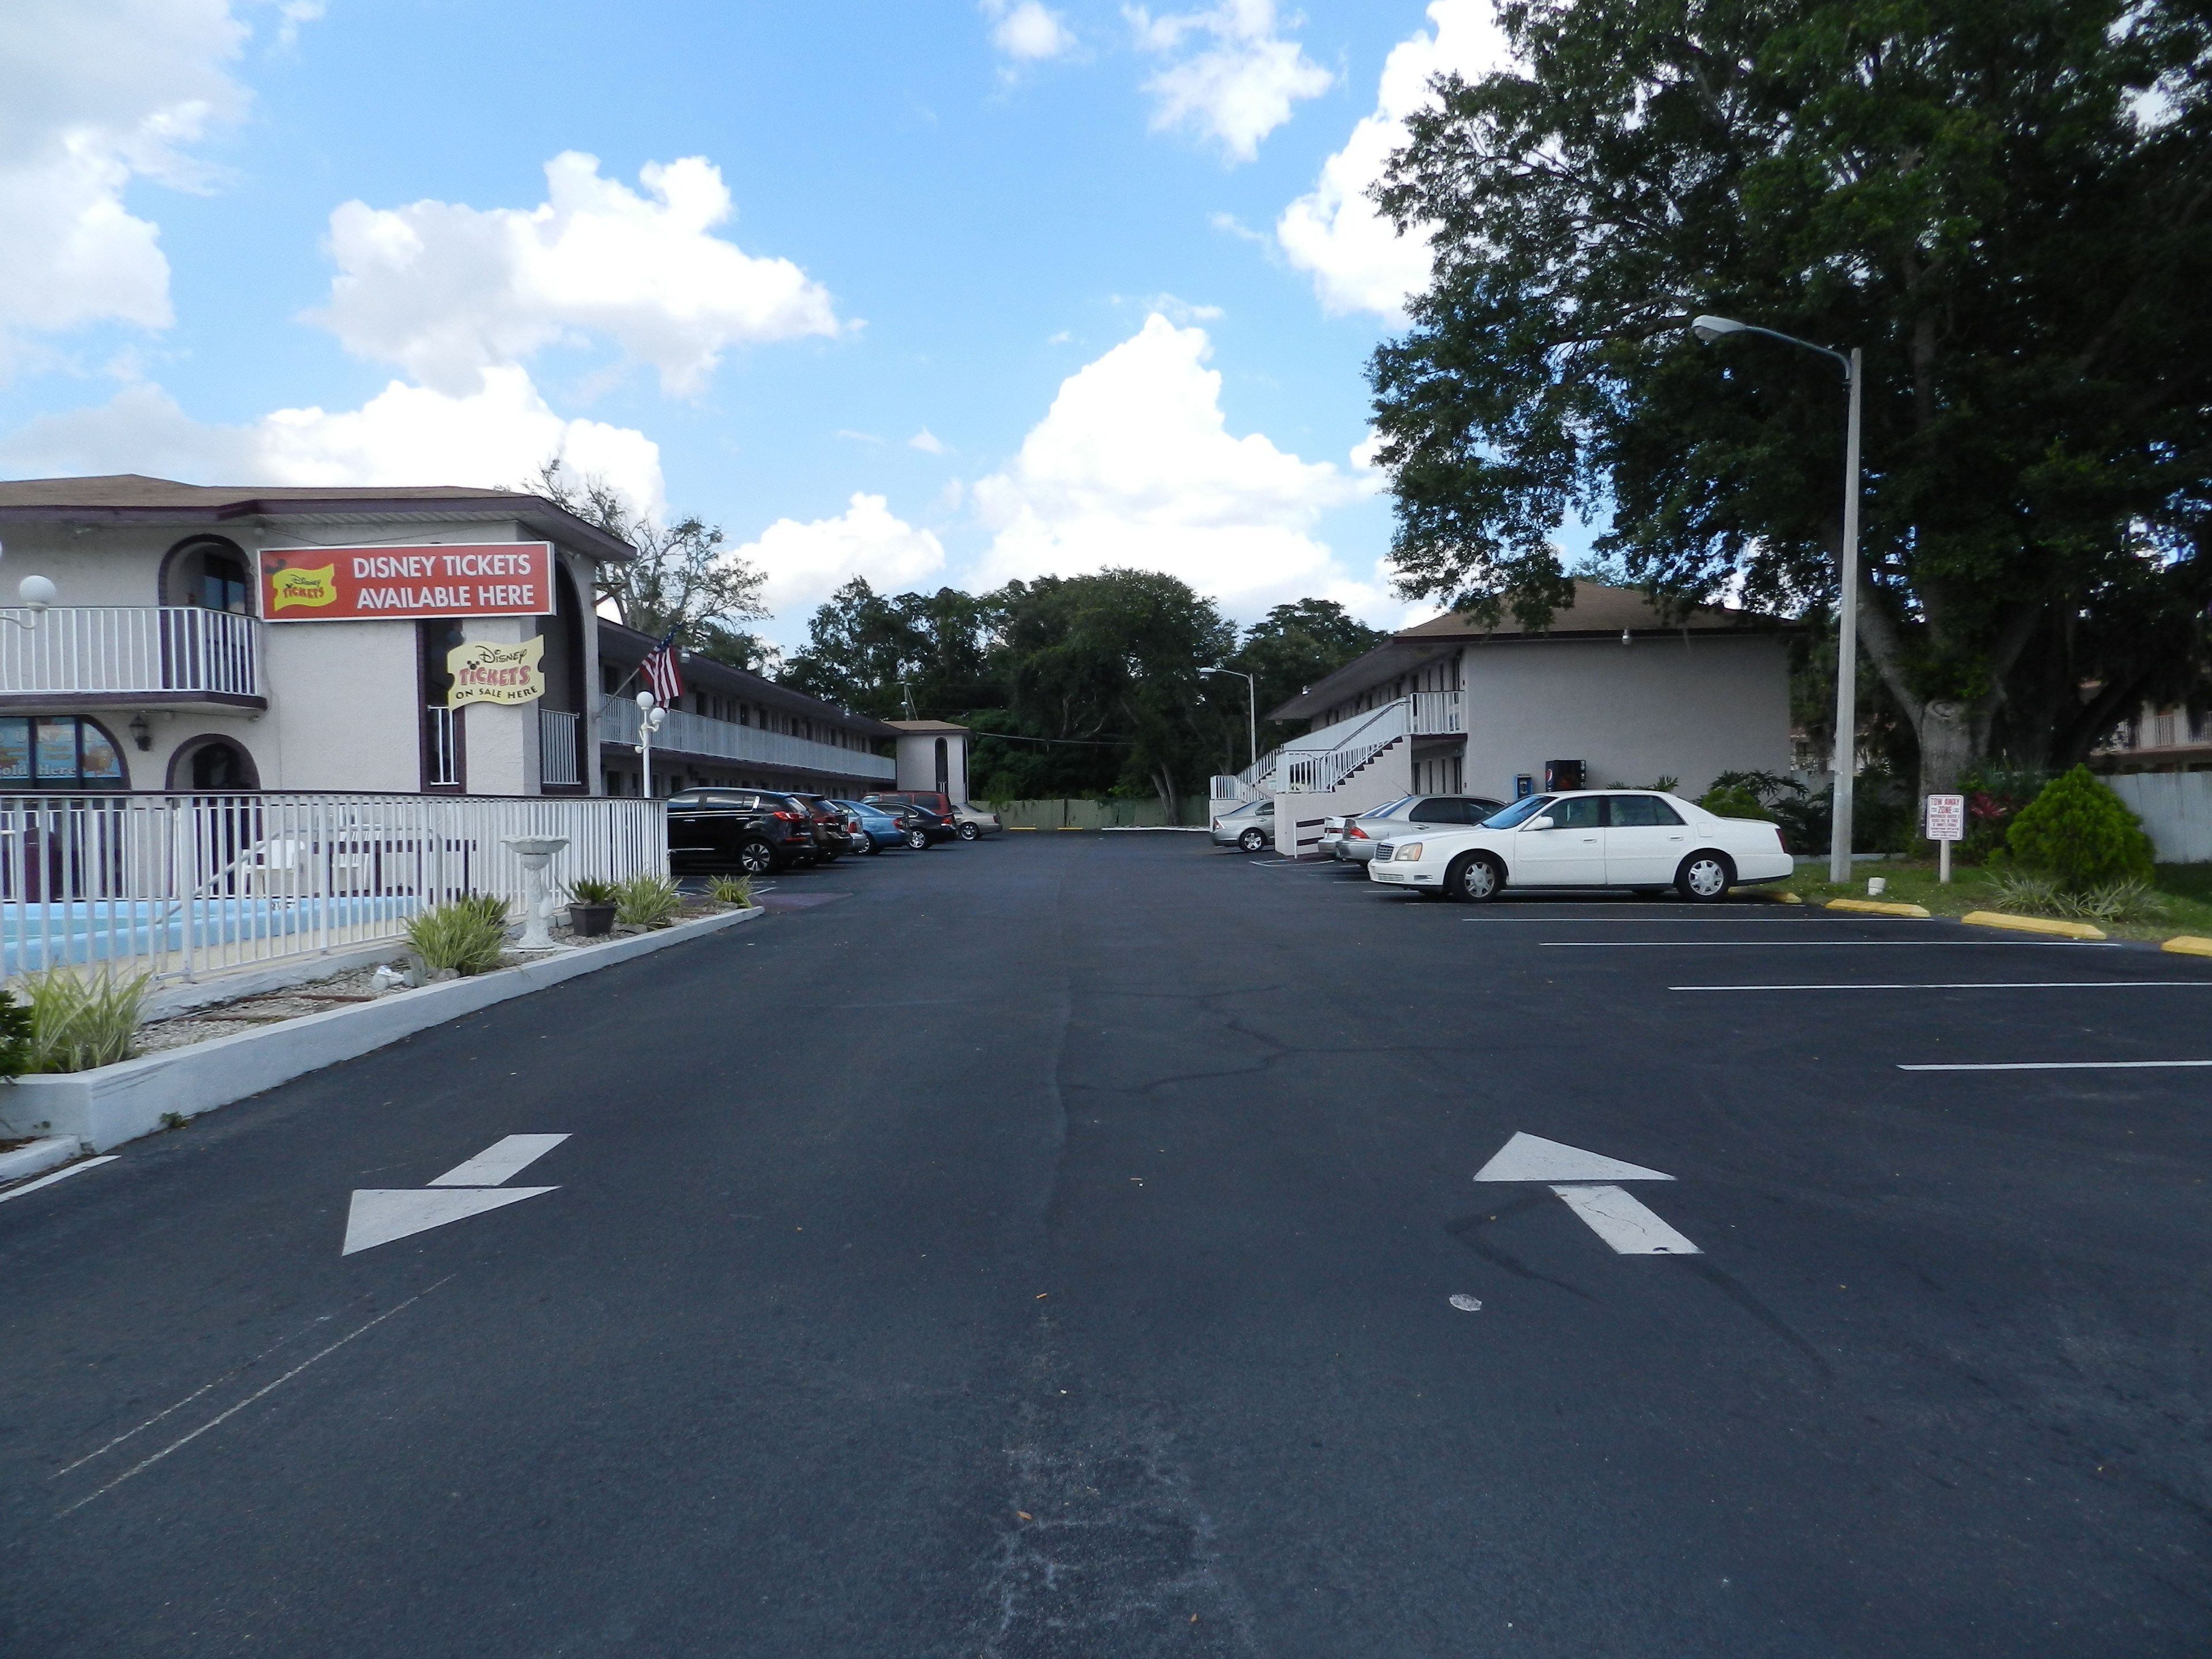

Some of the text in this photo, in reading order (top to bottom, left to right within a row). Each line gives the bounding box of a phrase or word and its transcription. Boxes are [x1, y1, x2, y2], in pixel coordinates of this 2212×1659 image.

[353, 554, 531, 578] DISNEY TICKETS
[357, 584, 534, 609] AVAILABLE HERE
[459, 665, 531, 686] TICKETS
[456, 685, 537, 699] ON SALE HERE
